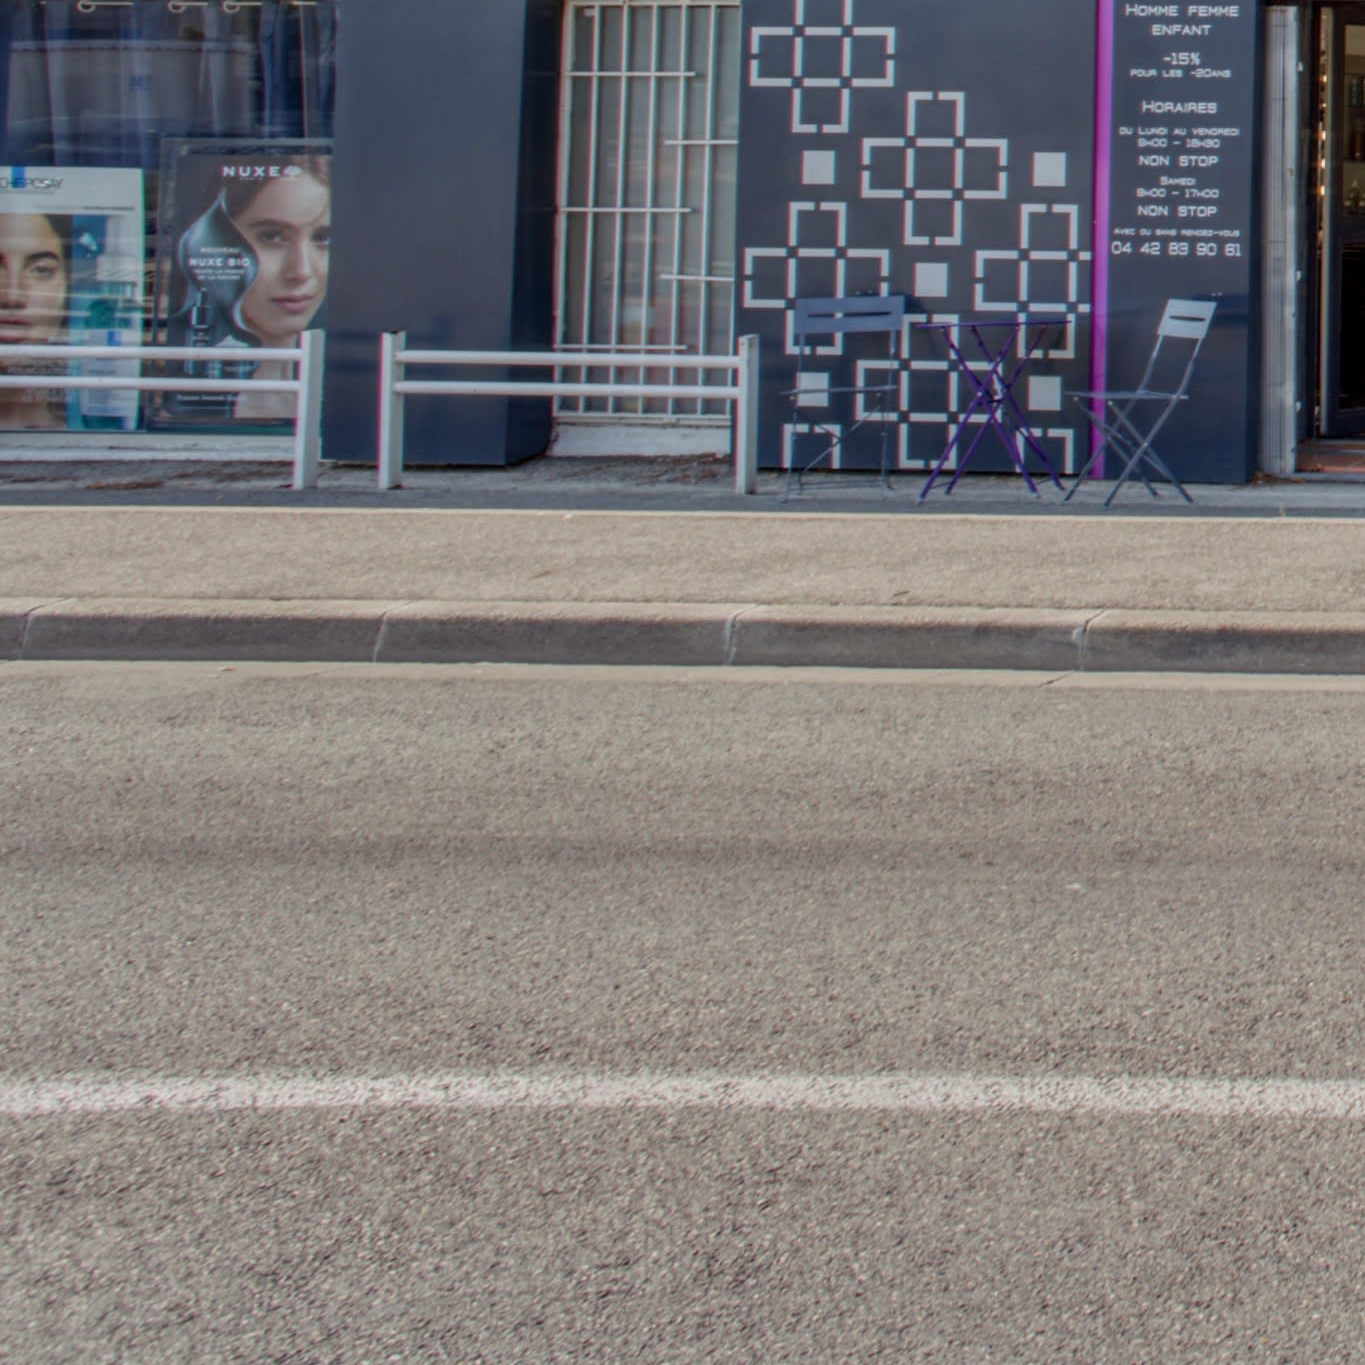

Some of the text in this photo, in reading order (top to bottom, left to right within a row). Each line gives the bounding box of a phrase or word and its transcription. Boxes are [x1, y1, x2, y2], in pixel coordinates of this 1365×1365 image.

[1125, 4, 1239, 17] HOMME FEMME
[1151, 24, 1212, 36] ENFANT
[1163, 52, 1200, 66] -15%
[1130, 68, 1157, 78] POUR
[1162, 68, 1183, 78] LES
[1142, 100, 1218, 114] HORAIRES
[1118, 126, 1240, 136] DU LUNDI AU VENDREDI
[1138, 155, 1219, 167] NON STOP
[222, 165, 280, 177] NUXE
[1160, 176, 1196, 186] SAMEDI
[1137, 205, 1218, 217] NON STOP
[1113, 227, 1136, 236] AVEC
[1140, 228, 1151, 236] OU
[1155, 228, 1177, 236] SANS
[1111, 241, 1132, 254] 04
[1140, 241, 1161, 255] 42
[1196, 242, 1217, 256] 90
[189, 257, 251, 267] NUXE BIO
